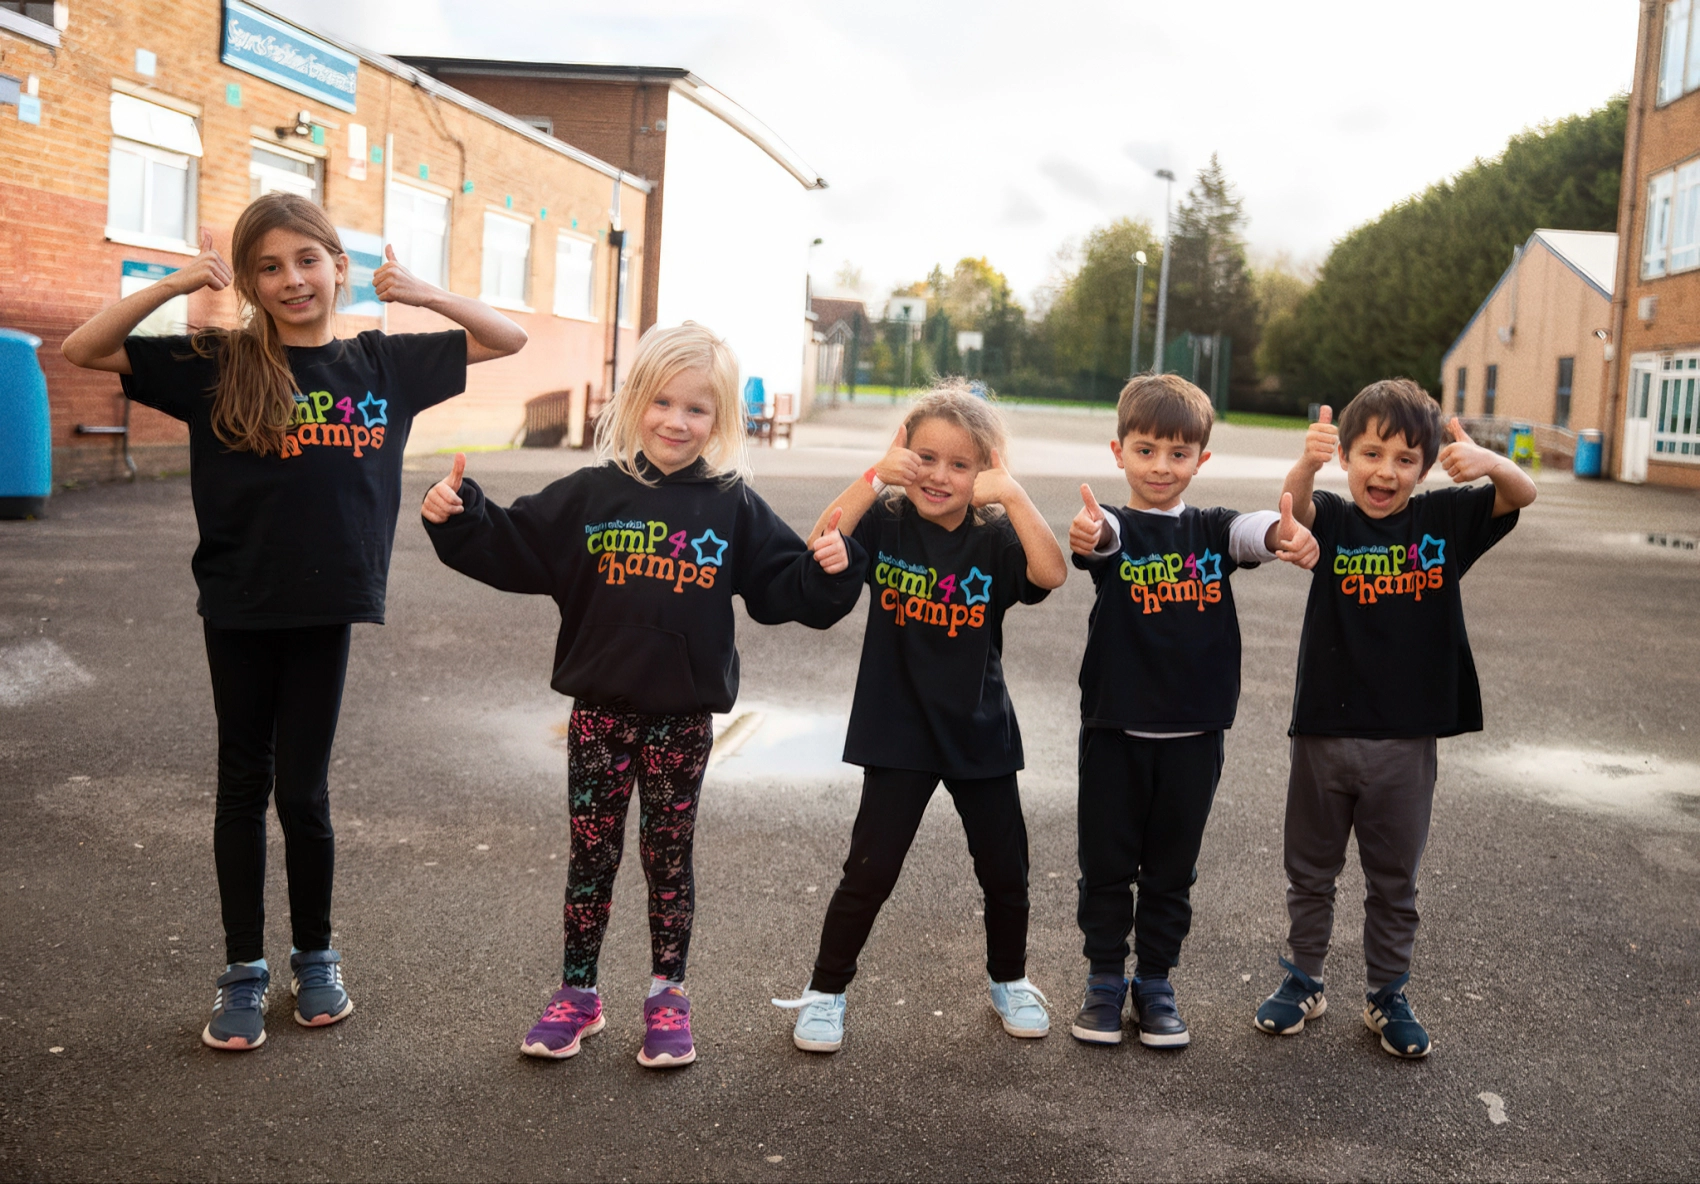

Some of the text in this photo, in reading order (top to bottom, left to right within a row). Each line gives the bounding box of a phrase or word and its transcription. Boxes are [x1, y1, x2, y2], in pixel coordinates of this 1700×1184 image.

[335, 395, 356, 424] 4
[280, 422, 387, 460] hamps
[668, 529, 688, 559] 4
[597, 552, 718, 594] champs
[1184, 551, 1199, 579] 4
[938, 573, 957, 603] 4
[1340, 566, 1444, 605] champs
[880, 588, 987, 638] champs
